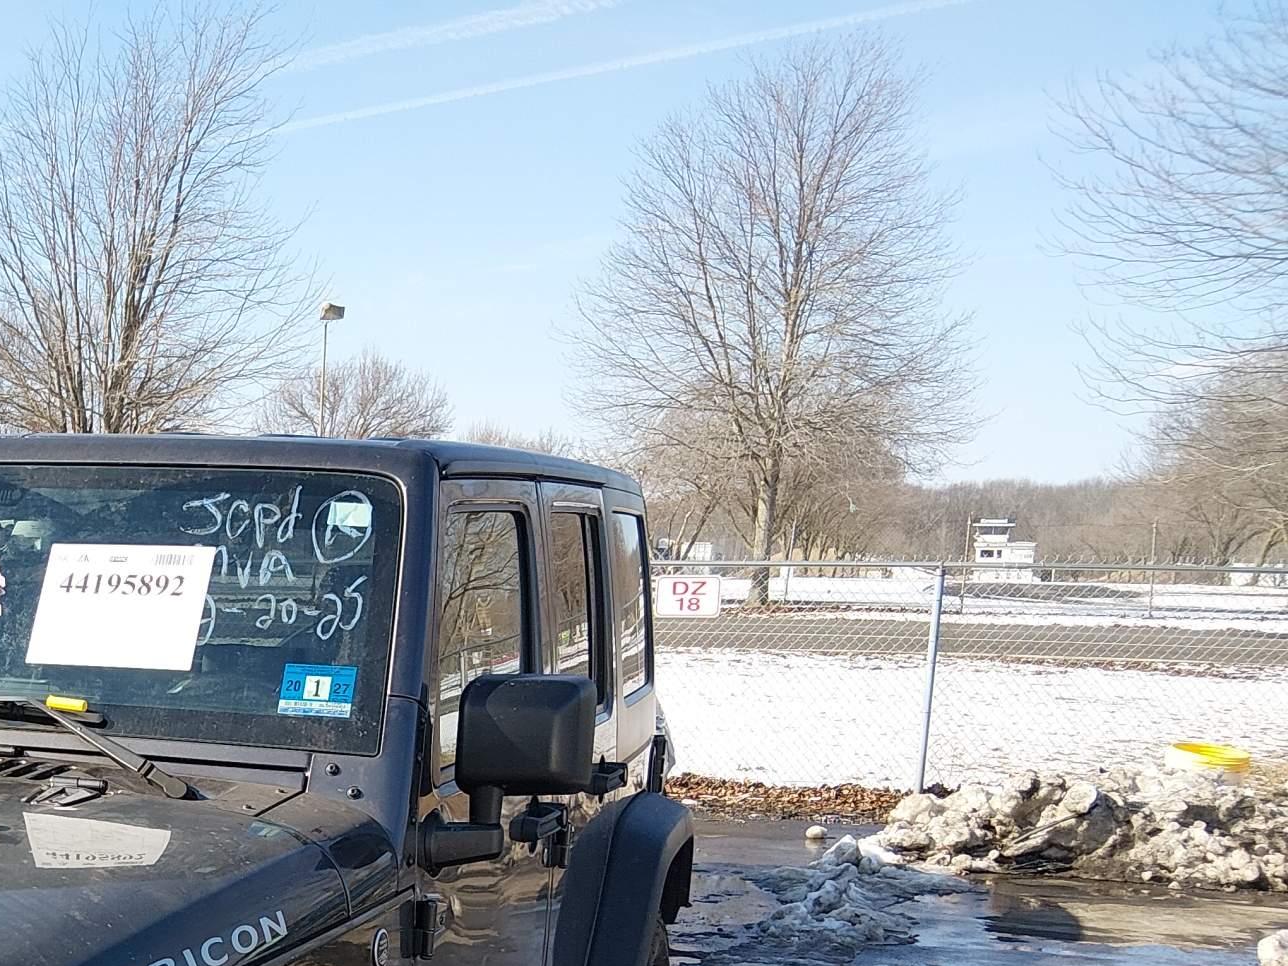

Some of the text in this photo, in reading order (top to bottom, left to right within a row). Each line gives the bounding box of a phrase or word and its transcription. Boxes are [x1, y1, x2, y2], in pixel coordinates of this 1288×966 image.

[60, 572, 185, 597] 44195892
[673, 581, 707, 595] DZ
[675, 598, 700, 611] 18
[286, 679, 351, 698] 20 1 27
